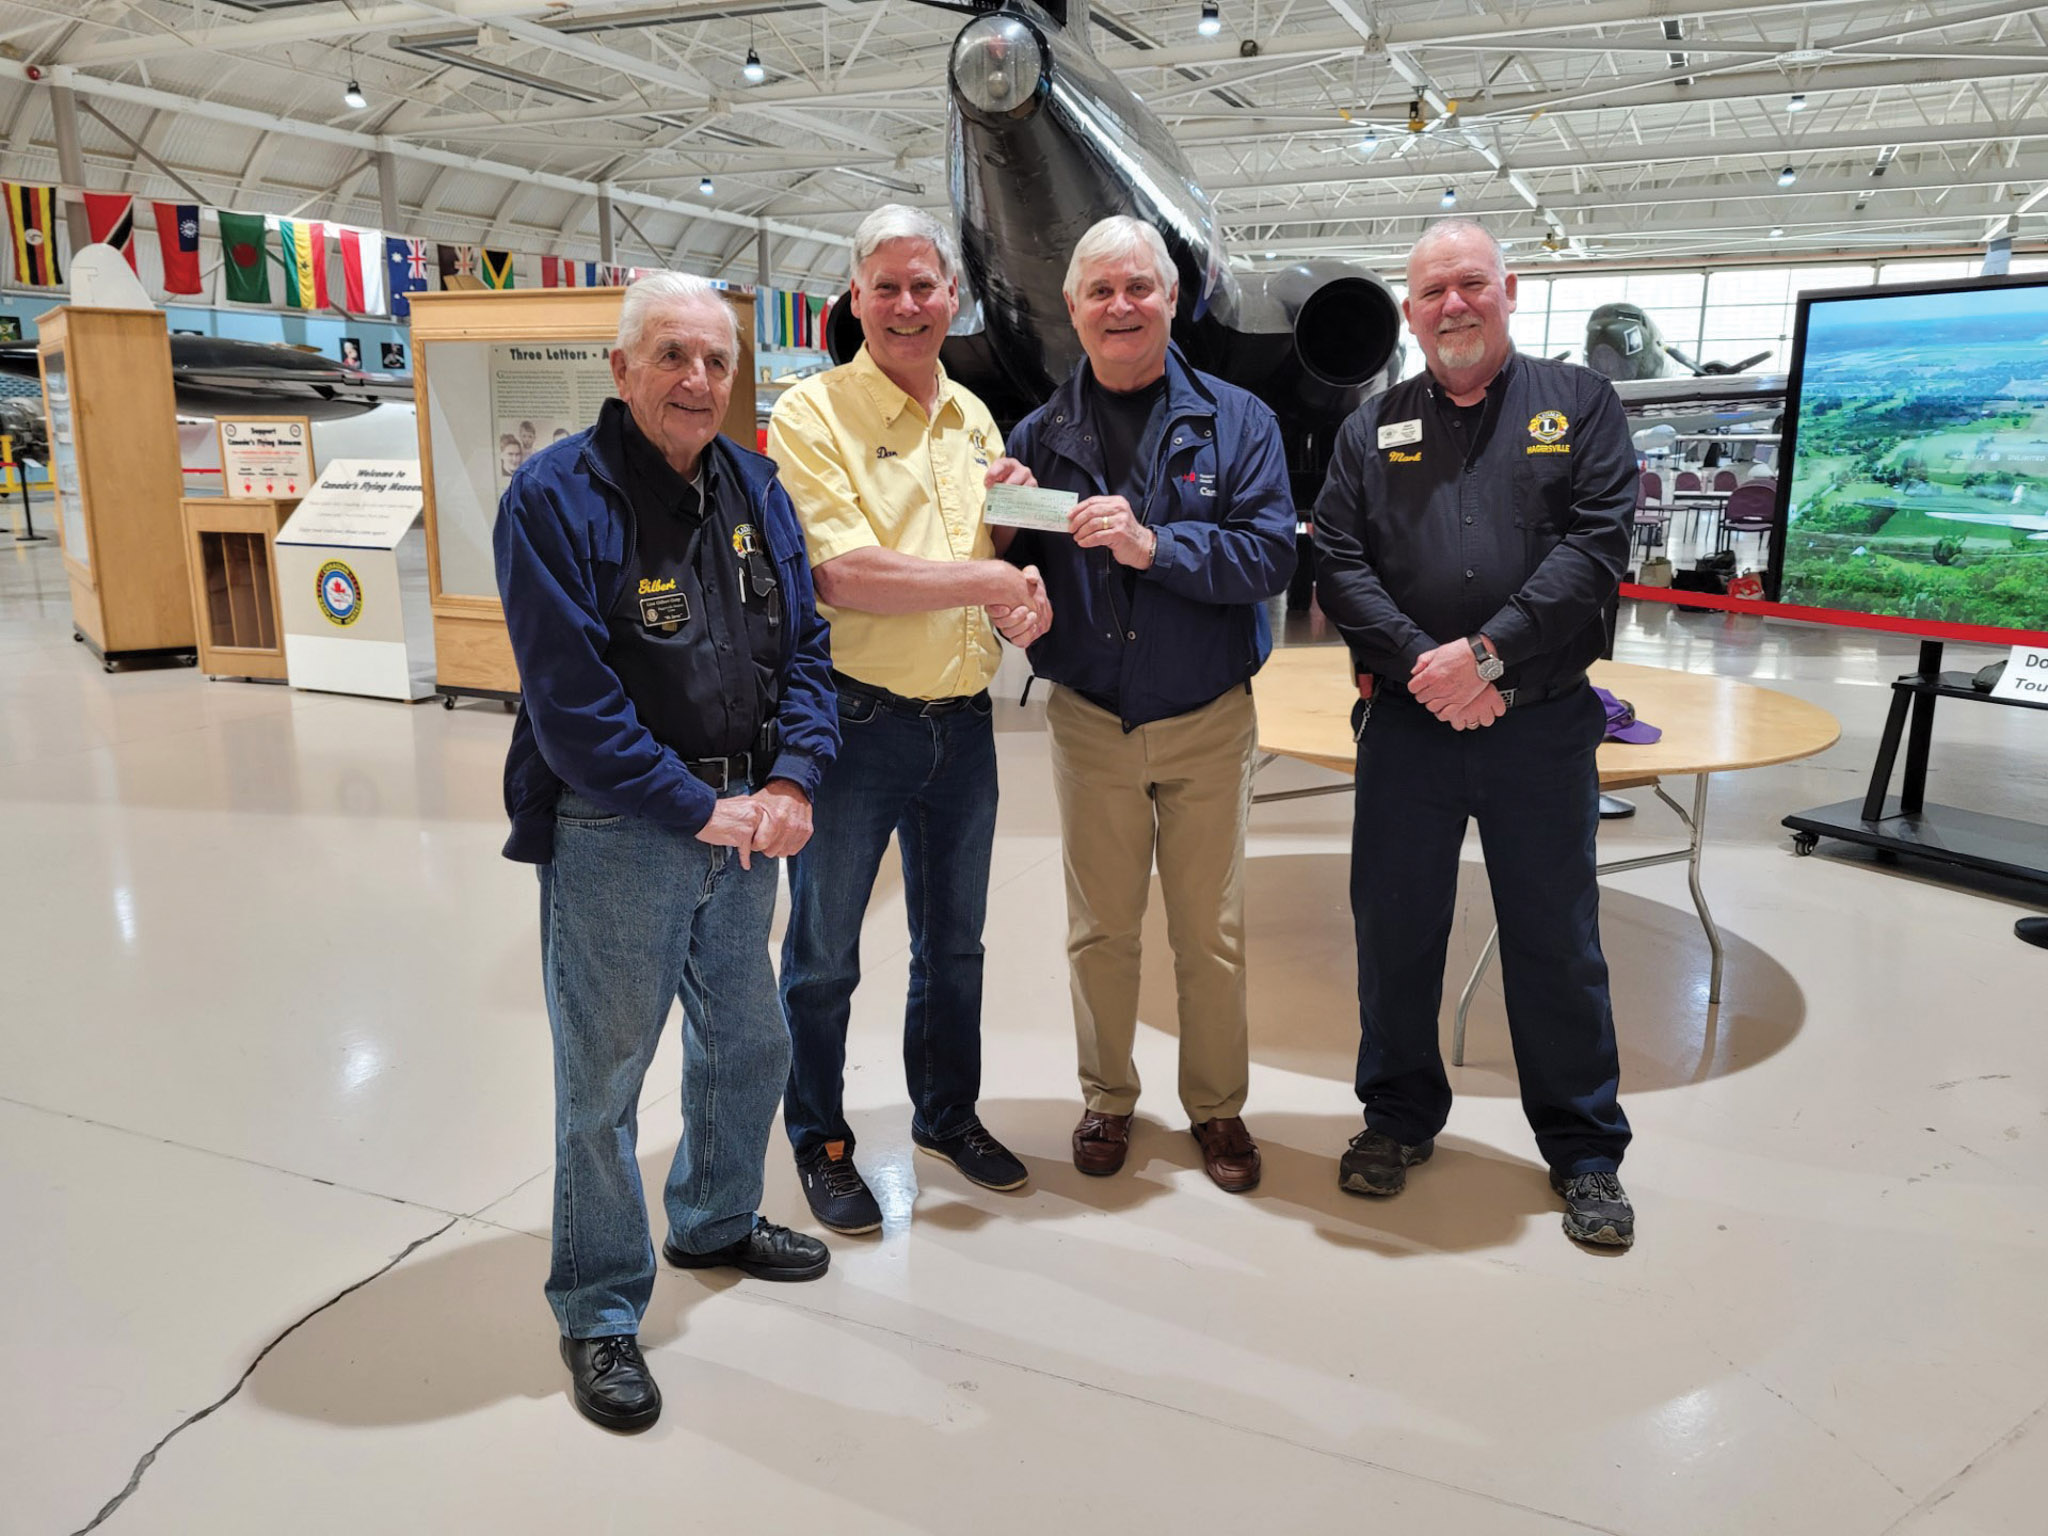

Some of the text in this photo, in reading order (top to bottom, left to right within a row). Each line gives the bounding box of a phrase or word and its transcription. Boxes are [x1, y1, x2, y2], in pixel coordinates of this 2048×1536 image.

[510, 348, 542, 360] Three
[546, 348, 588, 360] Letters
[1542, 418, 1556, 433] L
[1526, 444, 1571, 455] HAGERSVILLE
[1389, 451, 1422, 462] Mark
[357, 469, 394, 478] Welcome
[321, 481, 358, 490] Canada's
[360, 482, 387, 492] Flying
[638, 578, 677, 595] Gilbert
